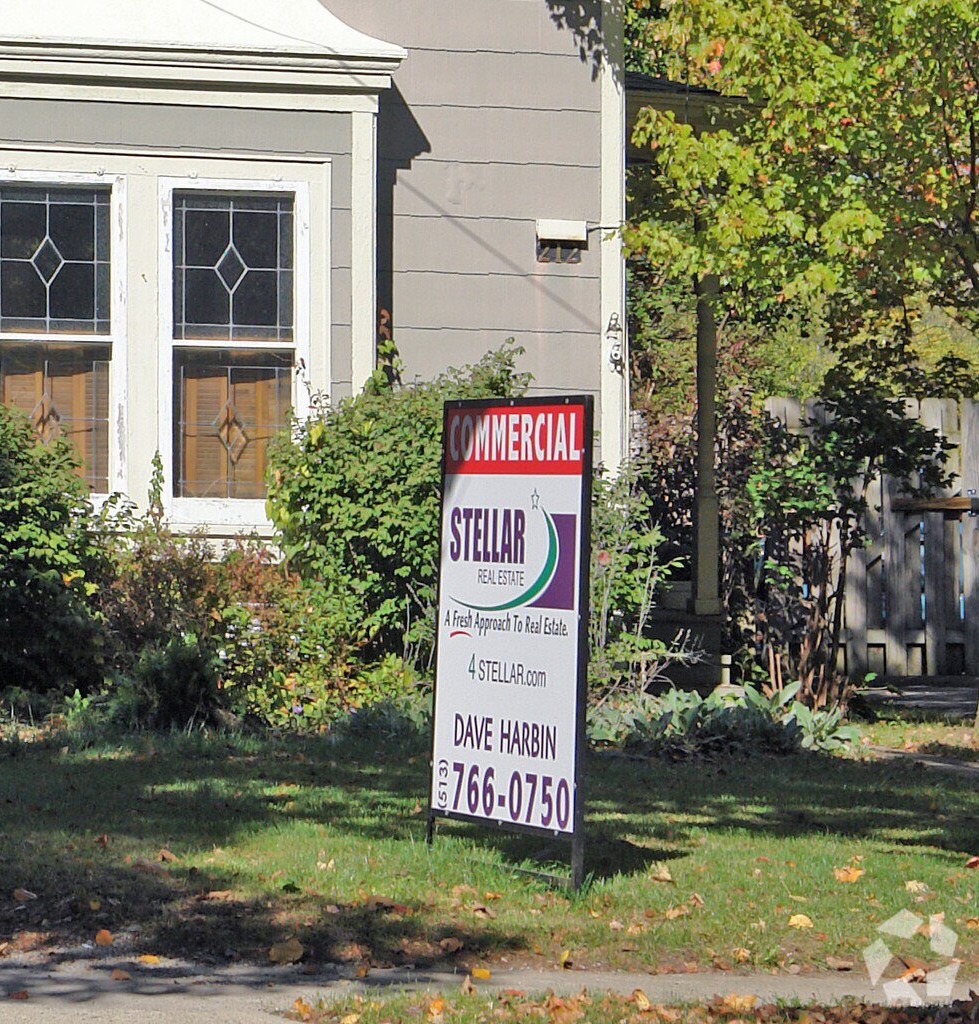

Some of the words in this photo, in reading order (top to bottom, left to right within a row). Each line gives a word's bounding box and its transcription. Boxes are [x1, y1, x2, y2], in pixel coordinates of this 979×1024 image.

[449, 412, 581, 462] COMMERCIAL
[449, 506, 526, 564] STELLAR
[477, 568, 496, 585] REAL
[497, 570, 525, 587] ESTATE
[444, 609, 451, 627] A
[452, 609, 473, 629] Fresh
[473, 611, 511, 637] Approach
[513, 614, 523, 633] To
[524, 614, 542, 635] Real
[543, 616, 569, 637] Estate.
[453, 712, 494, 752] DAVE
[499, 718, 557, 761] HARBIN
[437, 759, 449, 809] (513)
[452, 761, 570, 830] 766-0750
